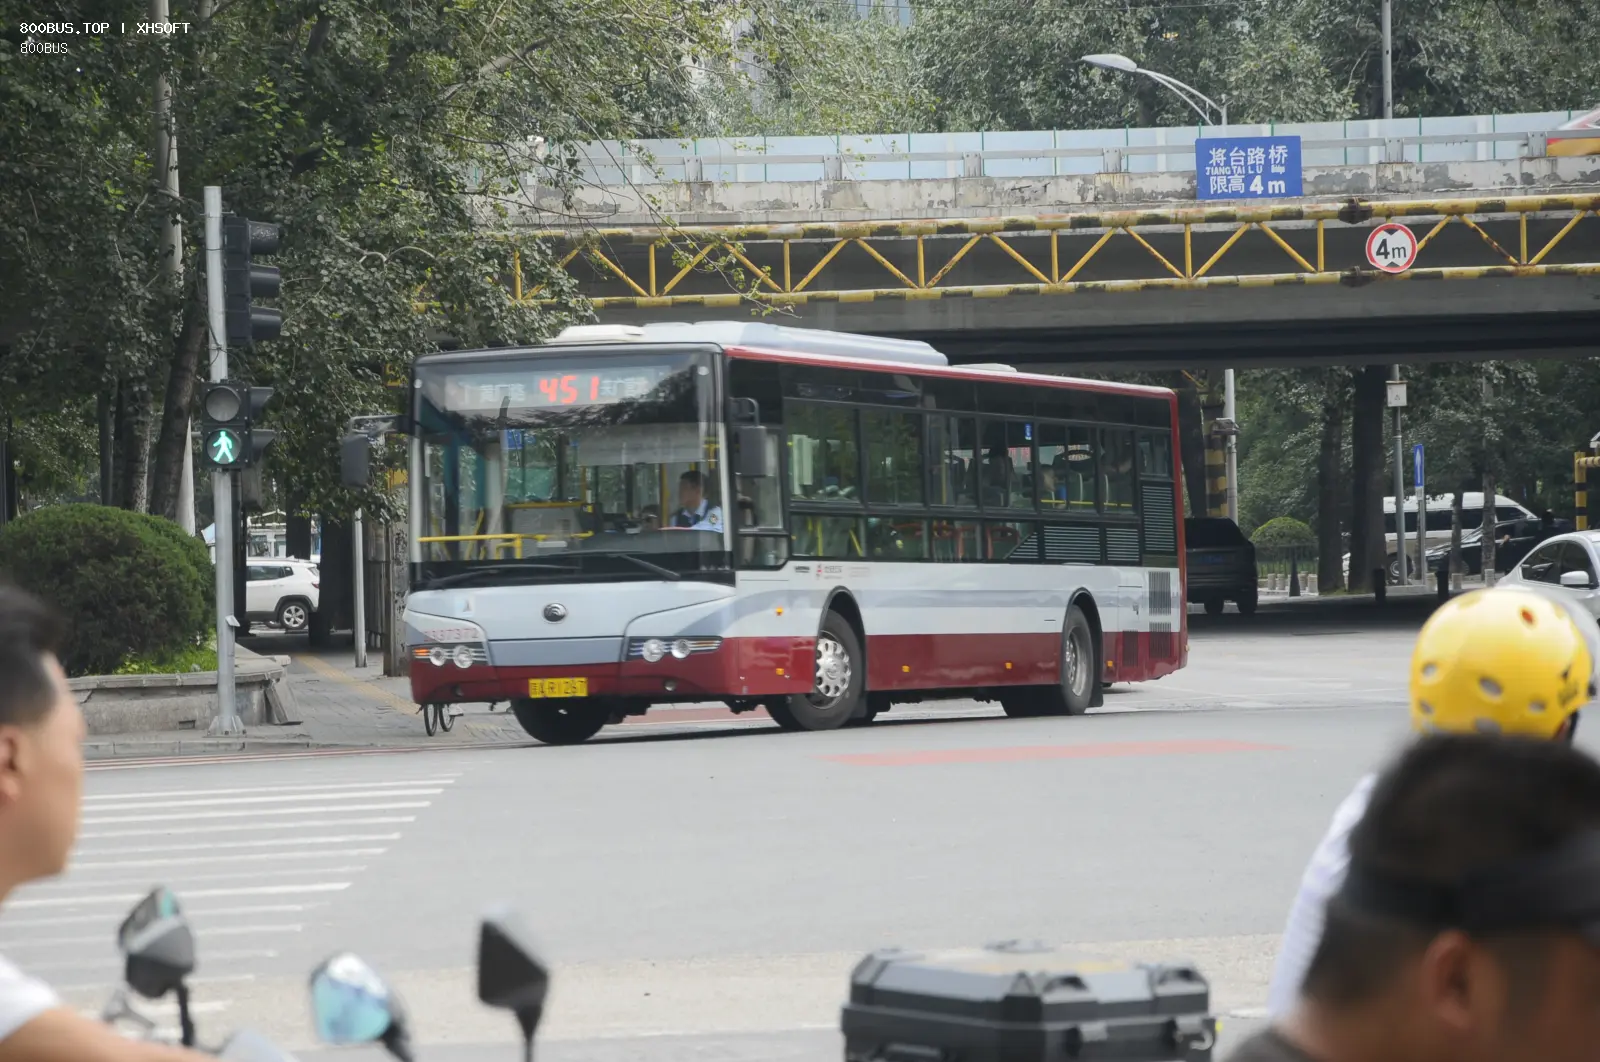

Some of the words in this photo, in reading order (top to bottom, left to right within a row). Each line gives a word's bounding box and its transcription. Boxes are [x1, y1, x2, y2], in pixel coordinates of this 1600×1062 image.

[1209, 144, 1288, 167] 将台路桥
[1375, 238, 1407, 260] 4m
[538, 374, 600, 404] 451
